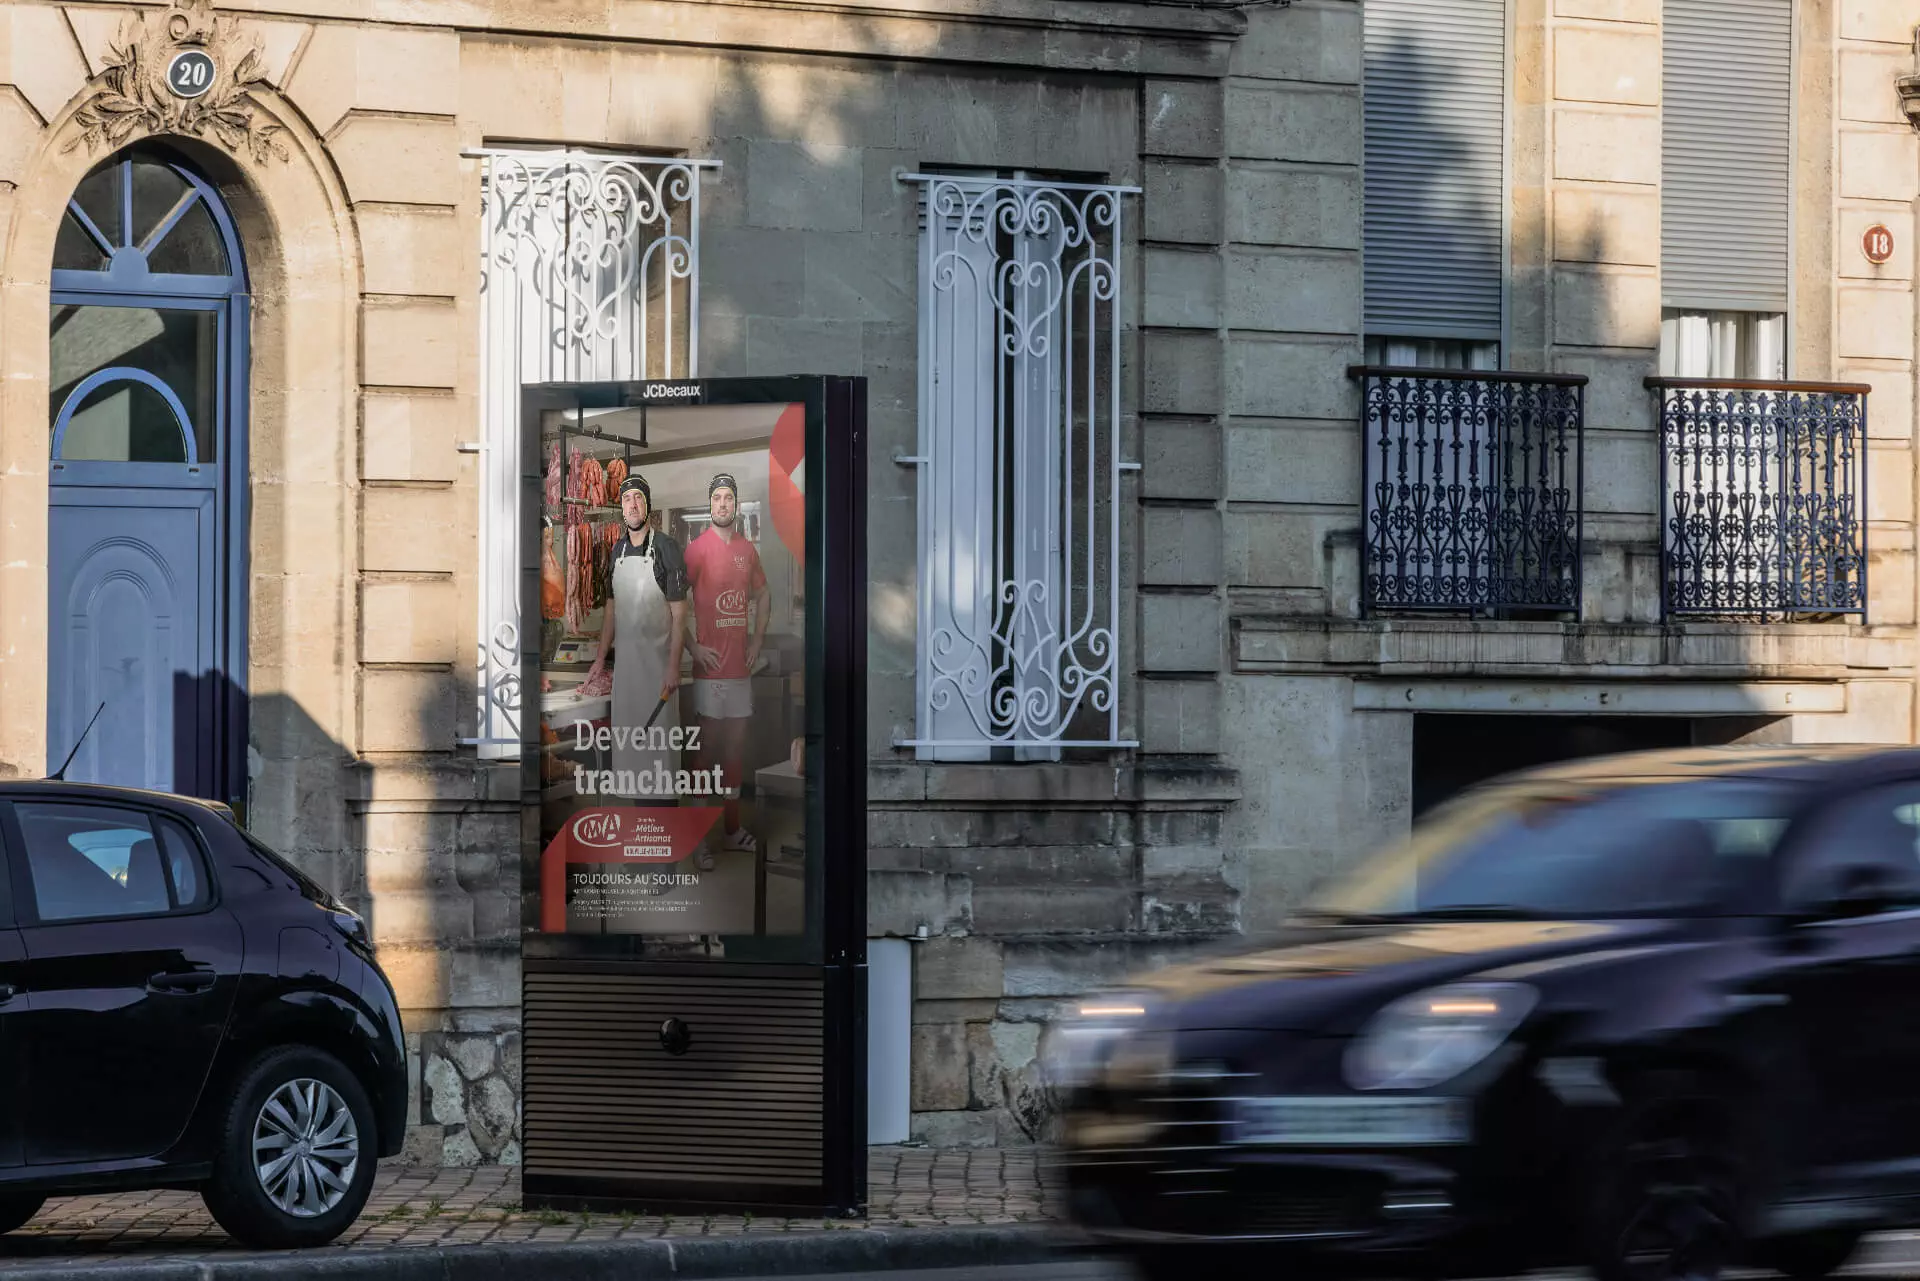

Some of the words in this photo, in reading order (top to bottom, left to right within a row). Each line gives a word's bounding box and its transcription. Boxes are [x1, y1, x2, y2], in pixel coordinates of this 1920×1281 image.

[177, 62, 206, 86] 20
[1872, 233, 1888, 254] 18
[643, 384, 701, 398] JCDecaux
[573, 719, 701, 751] Devenez
[573, 759, 732, 795] tranchant.
[636, 824, 665, 833] Métiers
[635, 834, 672, 843] Artisanat
[573, 873, 631, 885] TOUJOURS
[633, 873, 649, 885] AU
[652, 873, 699, 885] SOUTIEN
